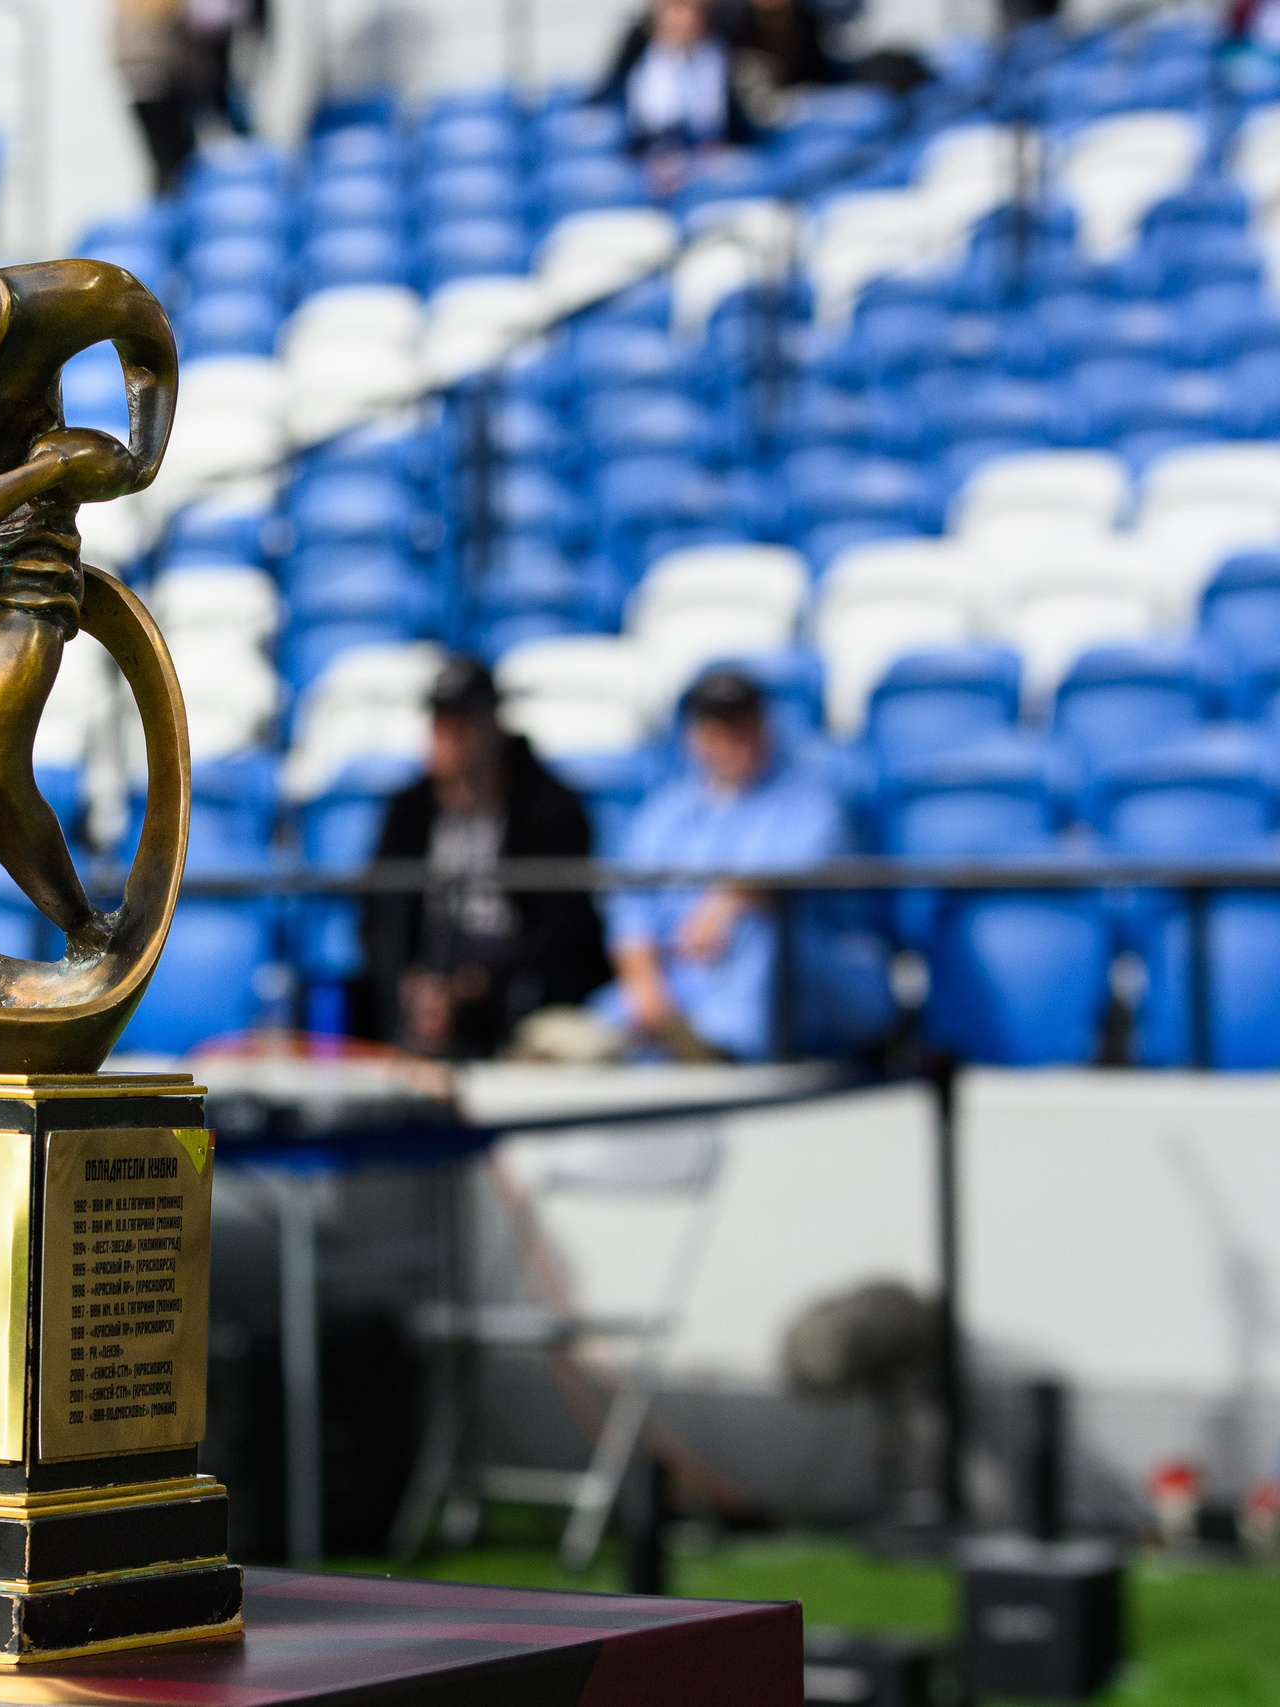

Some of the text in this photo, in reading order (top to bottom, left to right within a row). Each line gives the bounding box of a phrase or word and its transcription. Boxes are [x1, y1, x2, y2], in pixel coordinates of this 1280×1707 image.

[85, 1157, 178, 1182] ОБЛАДАТЕЛИ КУБКА
[73, 1199, 88, 1213] 1992
[73, 1220, 87, 1234] 1993
[72, 1241, 86, 1255] 1994
[72, 1262, 86, 1277] 1995
[71, 1283, 85, 1298] 1996
[71, 1305, 85, 1319] 1997
[70, 1326, 85, 1340] 1998
[70, 1347, 84, 1361] 1999
[89, 1346, 97, 1360] РК
[70, 1368, 84, 1382] 2000
[70, 1389, 84, 1403] 2001
[69, 1410, 84, 1425] 2002
